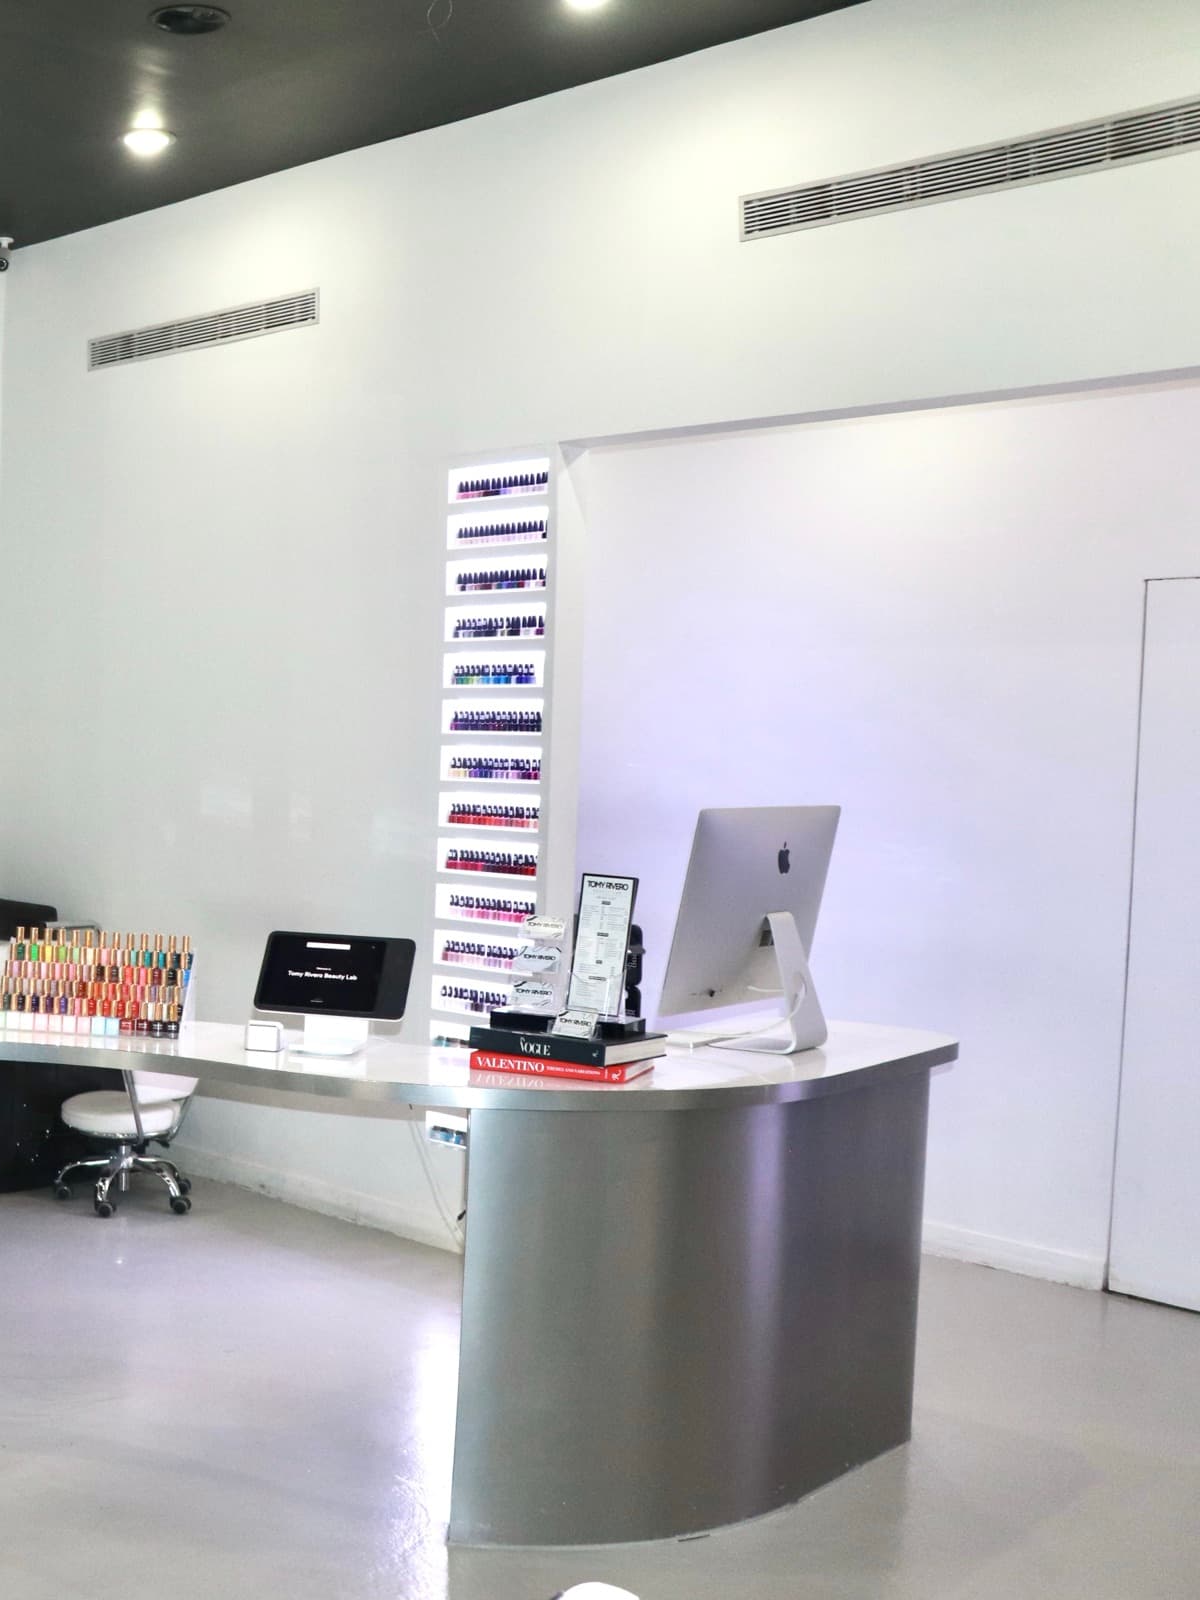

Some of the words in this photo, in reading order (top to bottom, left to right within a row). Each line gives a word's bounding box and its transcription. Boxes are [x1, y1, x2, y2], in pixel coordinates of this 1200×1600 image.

[587, 880, 605, 889] TOMY
[605, 882, 629, 891] RIVERO
[520, 1036, 551, 1056] VOGUE
[476, 1056, 545, 1073] VALENTINO
